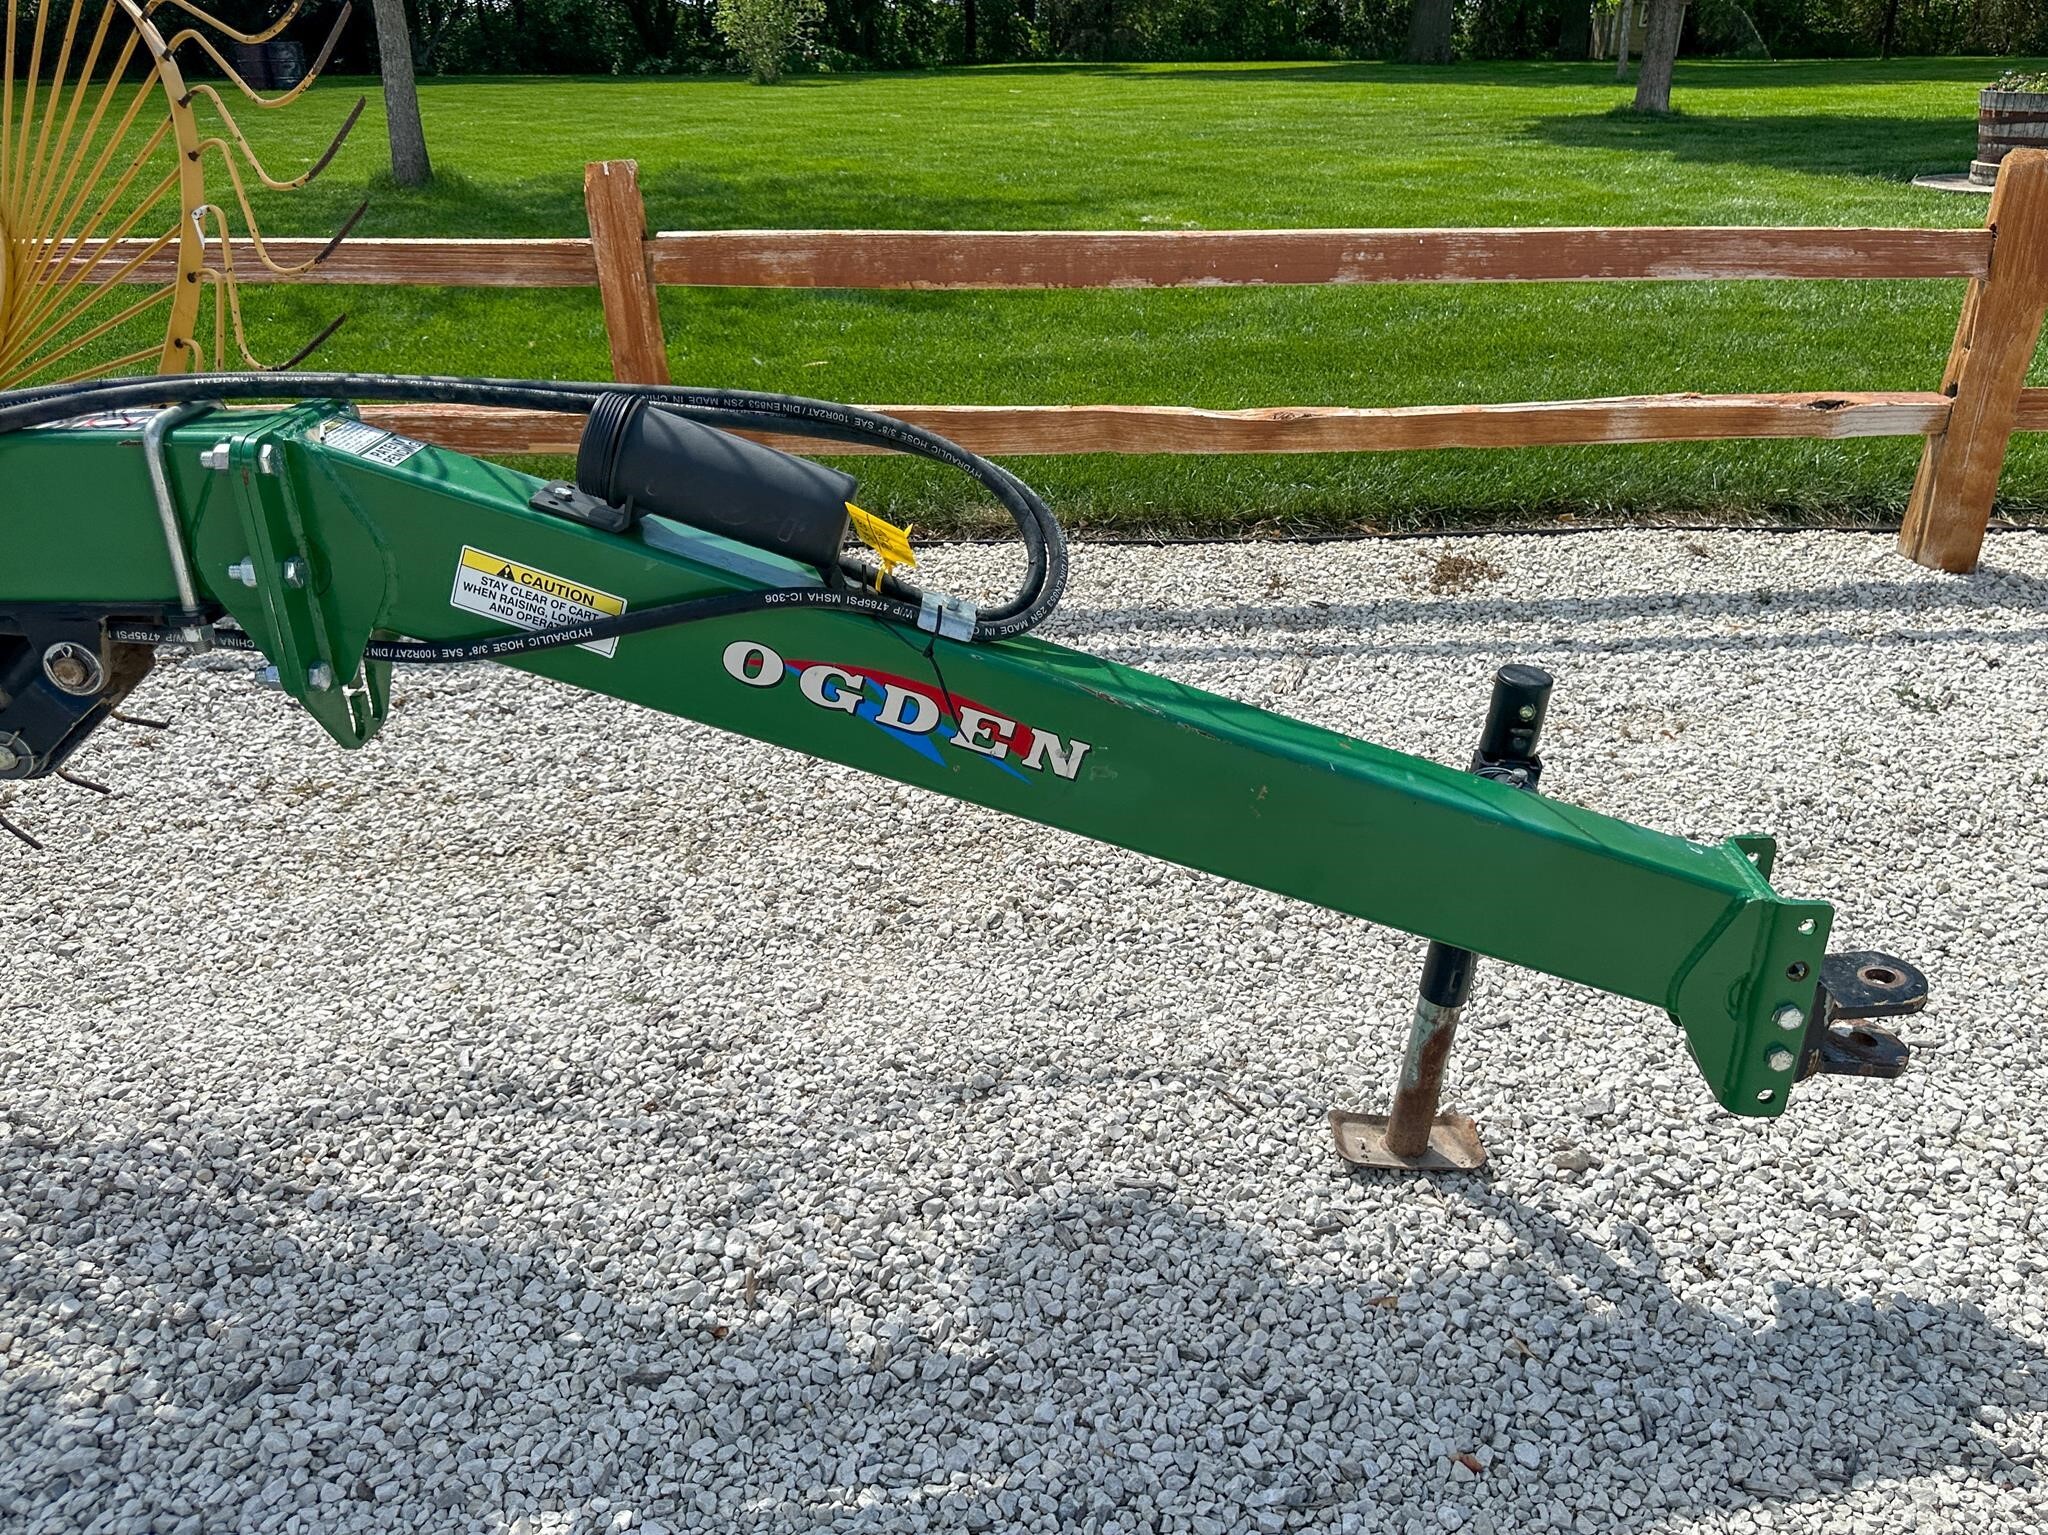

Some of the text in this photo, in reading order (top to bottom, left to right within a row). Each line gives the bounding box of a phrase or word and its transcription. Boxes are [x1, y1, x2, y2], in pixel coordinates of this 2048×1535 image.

[194, 376, 269, 384] HYDRAULIC
[673, 396, 684, 404] IN
[689, 396, 719, 406] MADE
[723, 399, 743, 408] 2SN
[749, 401, 780, 411] EN853
[782, 404, 801, 414] DIN
[807, 406, 849, 422] 100R2AT
[854, 417, 874, 430] SAE
[900, 431, 928, 448] HOSE
[931, 445, 983, 479] HYDRAULIC
[521, 572, 595, 606] CAUTION
[1047, 580, 1063, 608] EN853
[463, 581, 497, 599] WHEN
[500, 594, 548, 619] RAISING,
[480, 576, 600, 621] STAY CLEAR OF CART
[764, 592, 802, 604] IC-306
[808, 592, 841, 604] MSHA
[846, 596, 890, 611] 4785PSI
[489, 602, 514, 616] AND
[1030, 606, 1047, 623] 2SN
[984, 627, 996, 636] IN
[1000, 621, 1029, 635] MADE
[117, 629, 161, 642] 4785PSI
[528, 627, 593, 646] HYDRAULIC
[220, 638, 255, 649] CHINA
[492, 639, 525, 653] HOSE
[371, 647, 389, 658] DIN
[395, 647, 437, 659] 100R2AT
[442, 648, 464, 659] SAE
[722, 640, 1092, 781] OGDEN
